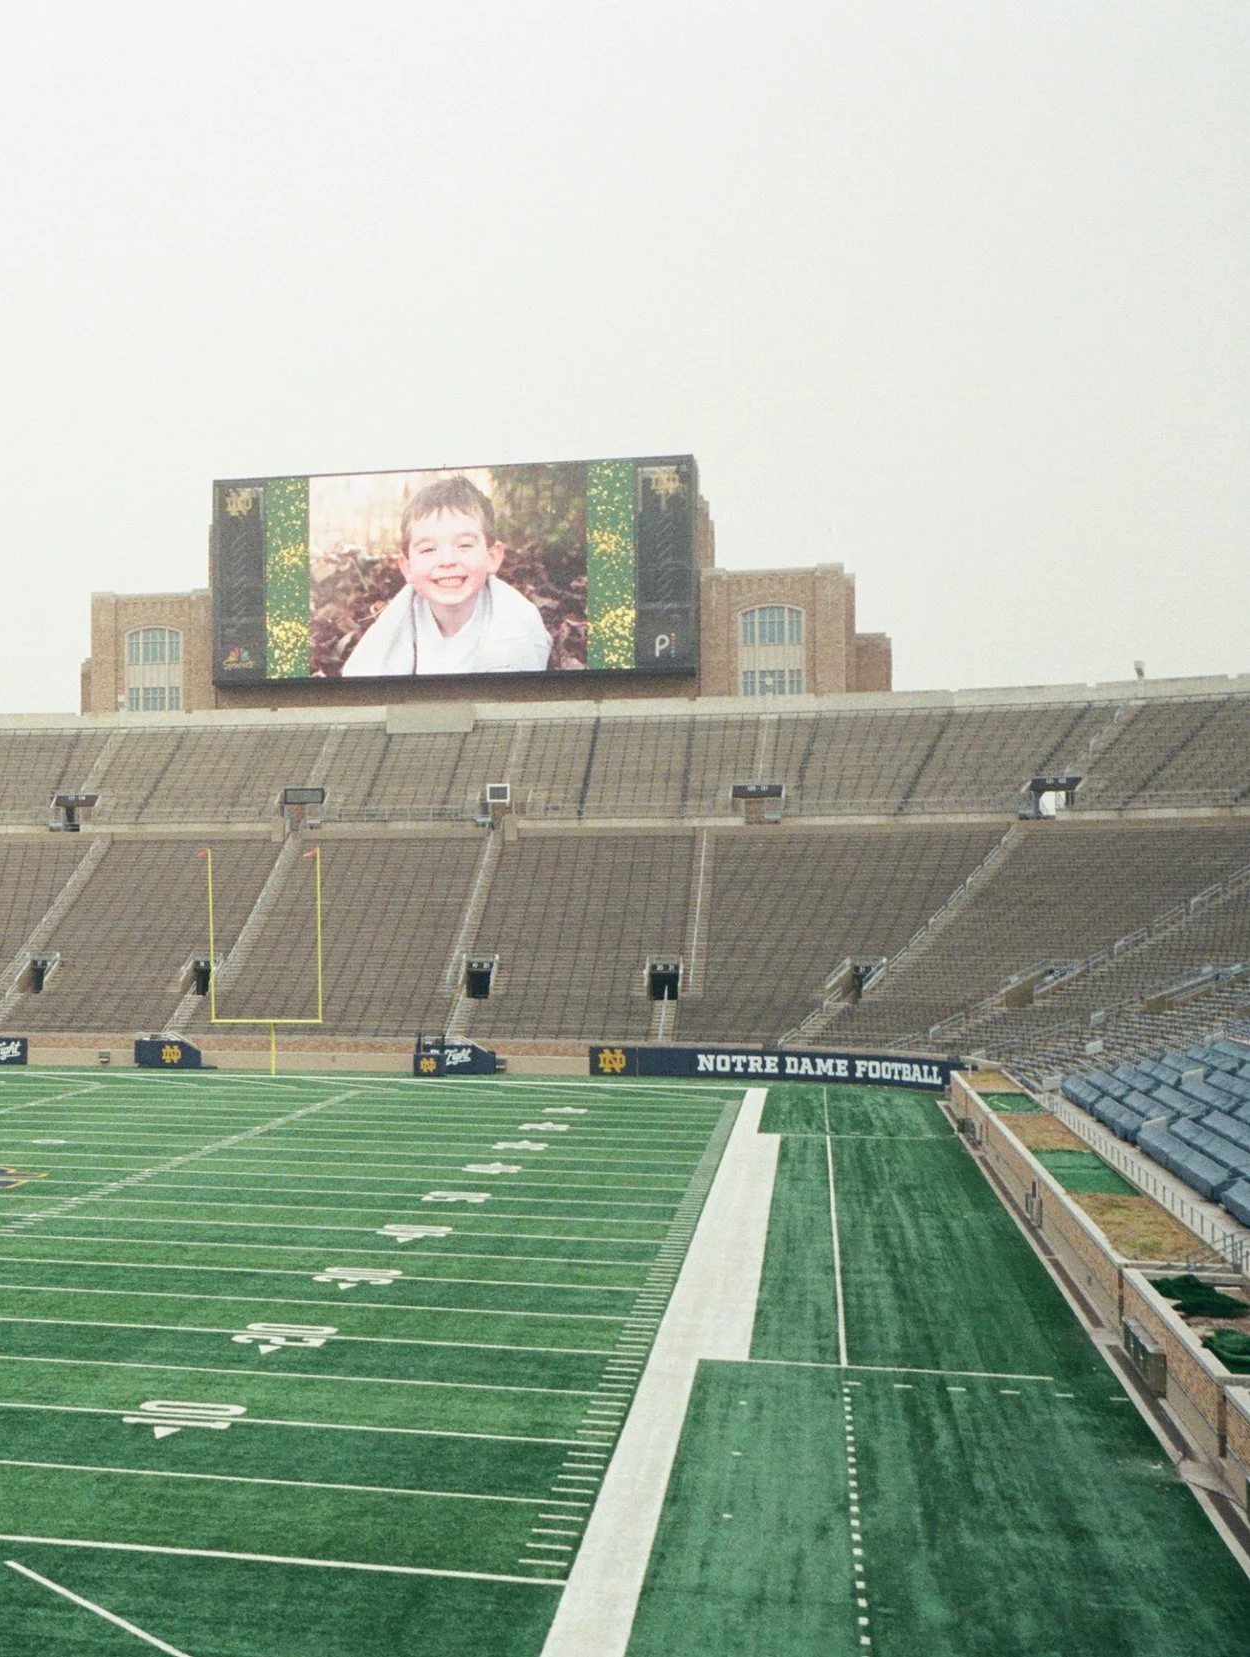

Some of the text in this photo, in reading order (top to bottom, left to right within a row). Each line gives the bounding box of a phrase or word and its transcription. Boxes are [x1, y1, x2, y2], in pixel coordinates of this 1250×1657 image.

[697, 1054, 943, 1085] NOTRE DAME FOOTBALL
[231, 1322, 339, 1348] 20
[122, 1400, 248, 1430] 10
